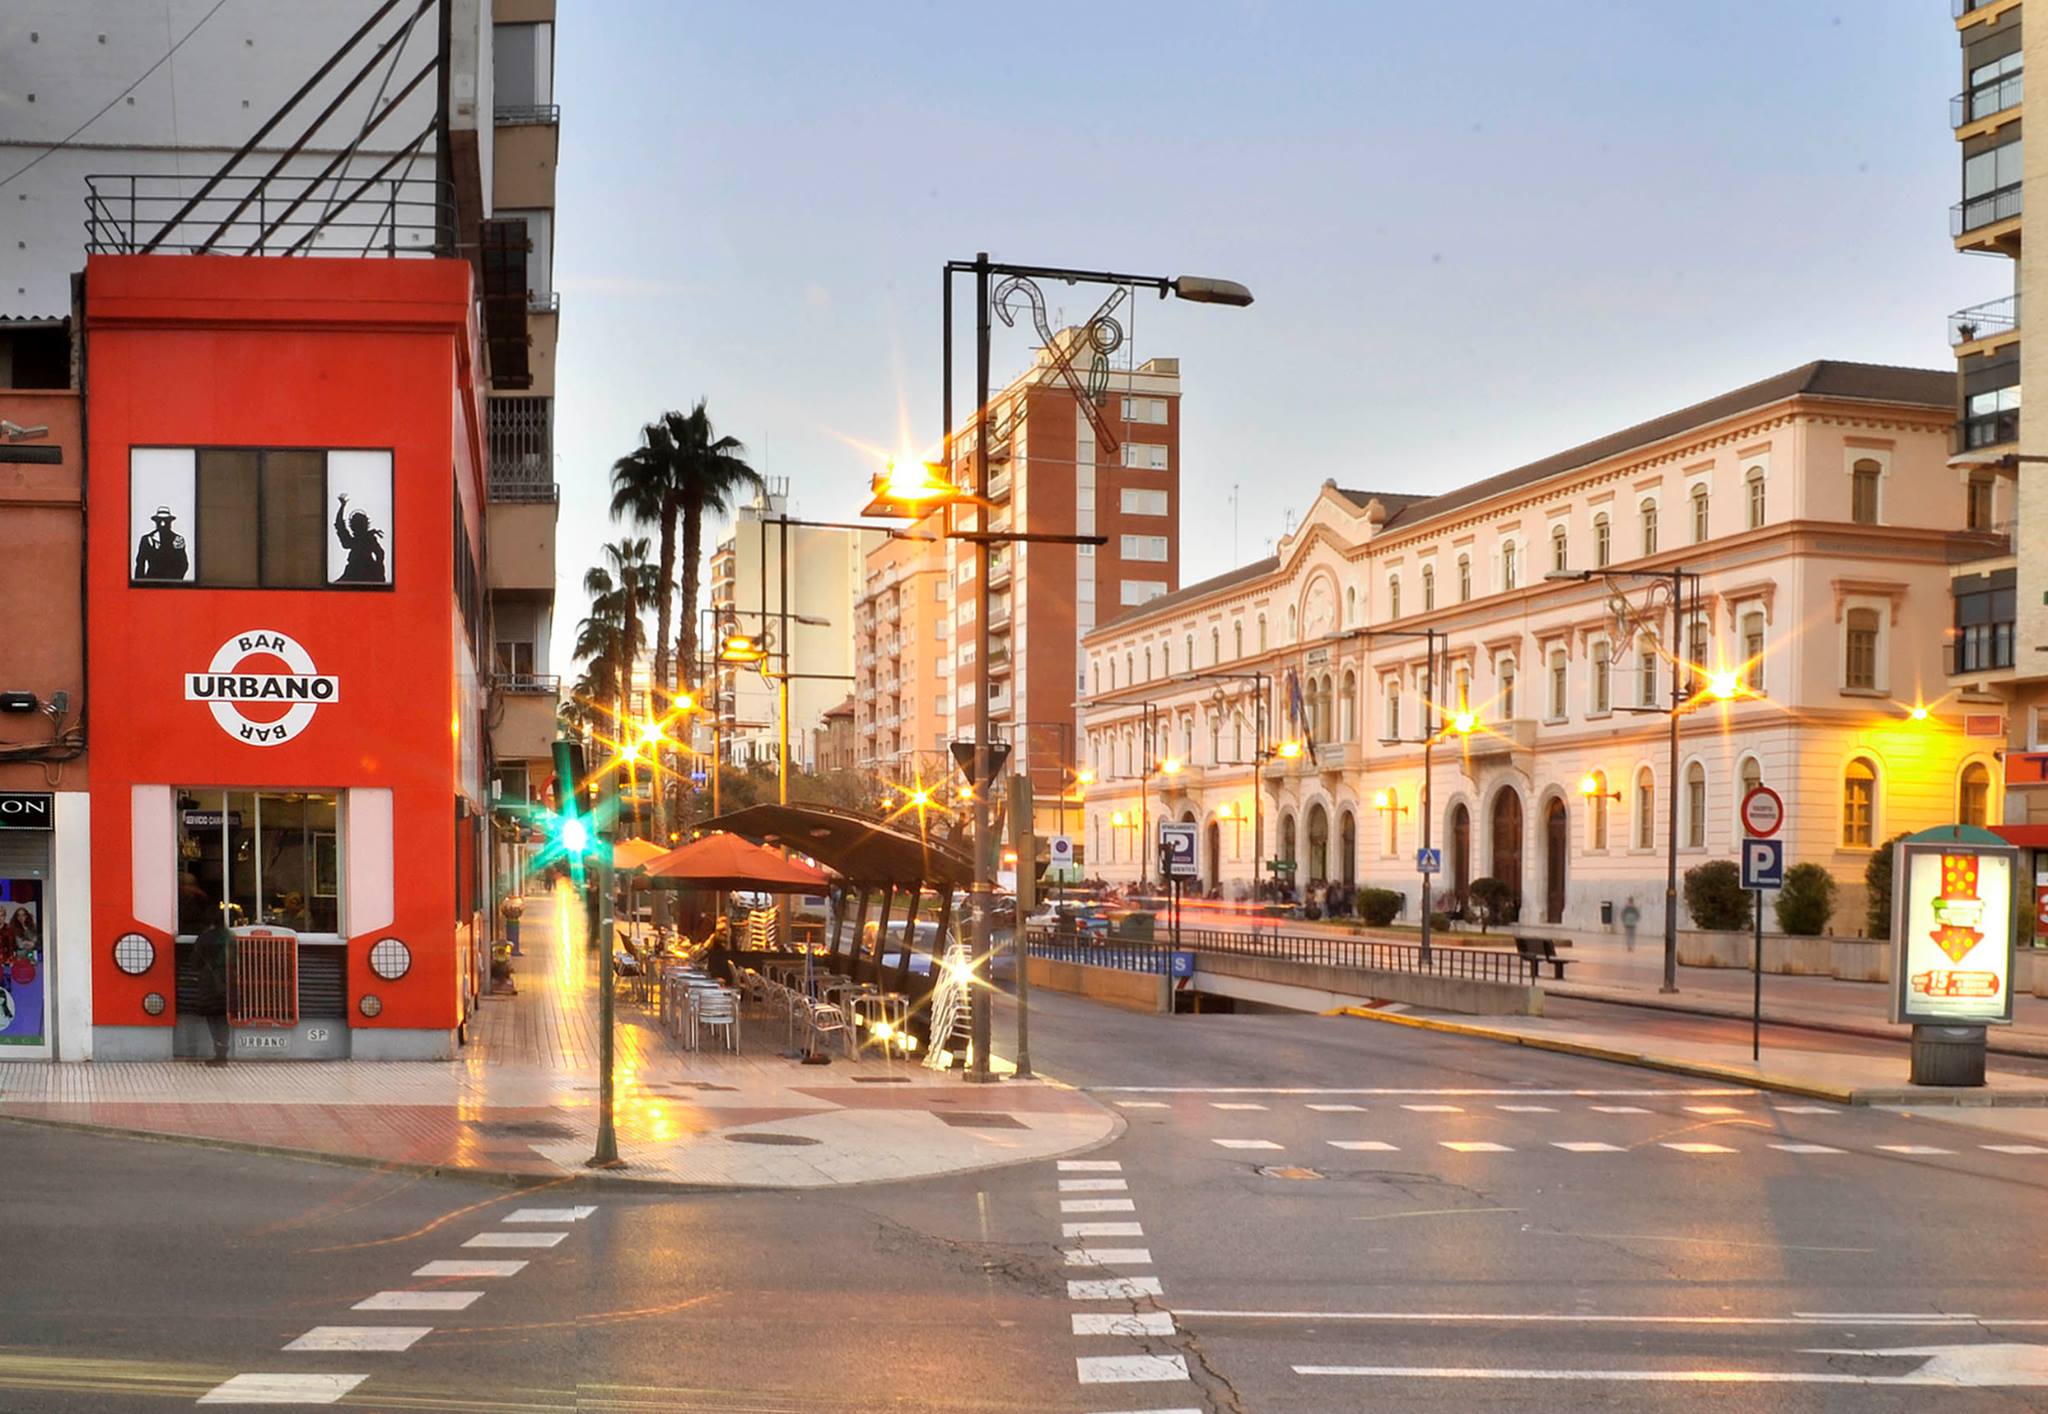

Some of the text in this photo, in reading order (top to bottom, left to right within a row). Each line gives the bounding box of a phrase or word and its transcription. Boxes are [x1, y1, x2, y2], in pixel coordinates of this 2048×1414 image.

[238, 634, 286, 653] BAR
[192, 676, 334, 699] URBANO
[239, 723, 287, 742] BAR
[1750, 845, 1774, 882] P
[1174, 957, 1187, 972] S
[240, 1037, 286, 1047] URBANO
[310, 1029, 326, 1040] SP
